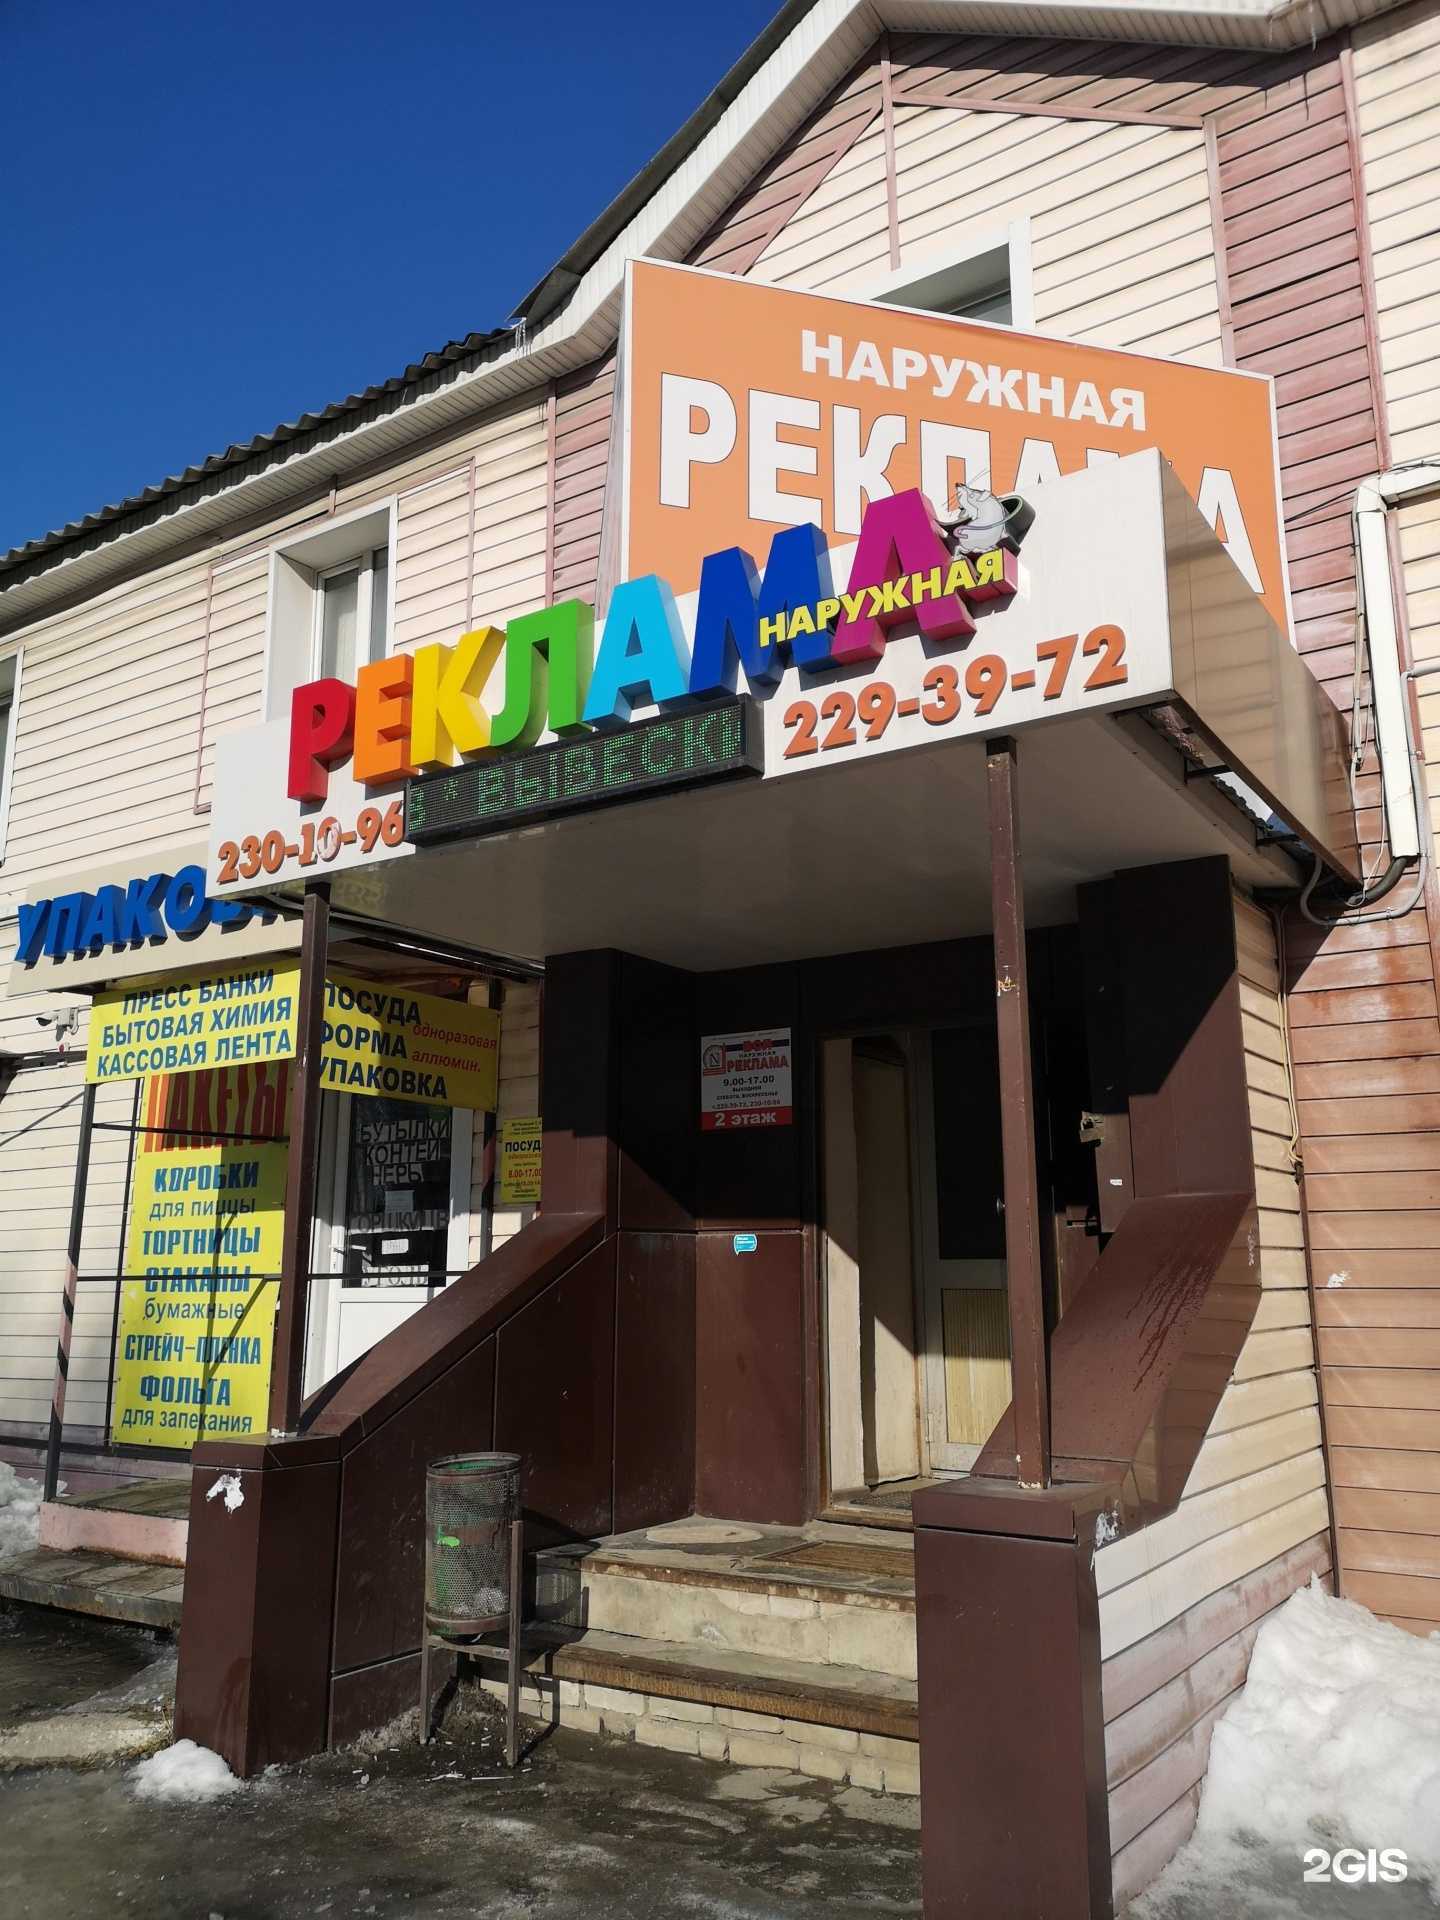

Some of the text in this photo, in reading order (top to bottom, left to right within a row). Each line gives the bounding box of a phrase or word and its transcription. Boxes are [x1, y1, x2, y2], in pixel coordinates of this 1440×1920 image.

[800, 329, 1147, 433] НАРУЖНАЯ
[659, 371, 1265, 596] РЕКЛА
[758, 549, 1006, 648] НАРУЖНАЯ
[288, 487, 978, 802] РЕКЛАМА
[783, 624, 1130, 761] 229-39-72
[216, 800, 405, 885] 230-10-96
[14, 864, 288, 969] УПАКО
[123, 969, 274, 1015] ПРЕСС БАНКИ
[324, 983, 422, 1026] ПОСУДА
[102, 997, 292, 1048] БЫТОВАЯ ХИМИЯ
[412, 1023, 498, 1049] одноразовая
[97, 1029, 291, 1077] КАССОВАЯ ЛЕНТА
[411, 1050, 481, 1073] аллюмин.
[727, 1055, 790, 1073] РЕКЛАМА
[723, 1075, 775, 1087] 9.00-17.00
[360, 1119, 450, 1143] БУТЫЛКИ
[714, 1112, 777, 1127] 2 этаж
[153, 1162, 260, 1192] КОРОБКИ
[150, 1198, 256, 1221] для пиццы
[142, 1227, 261, 1256] ТОРТНИЦЫ
[144, 1266, 252, 1293] СТАКАНЫ
[144, 1297, 245, 1324] бумажные
[140, 1375, 231, 1406] ФОЛЬГА
[122, 1409, 252, 1433] для запекания
